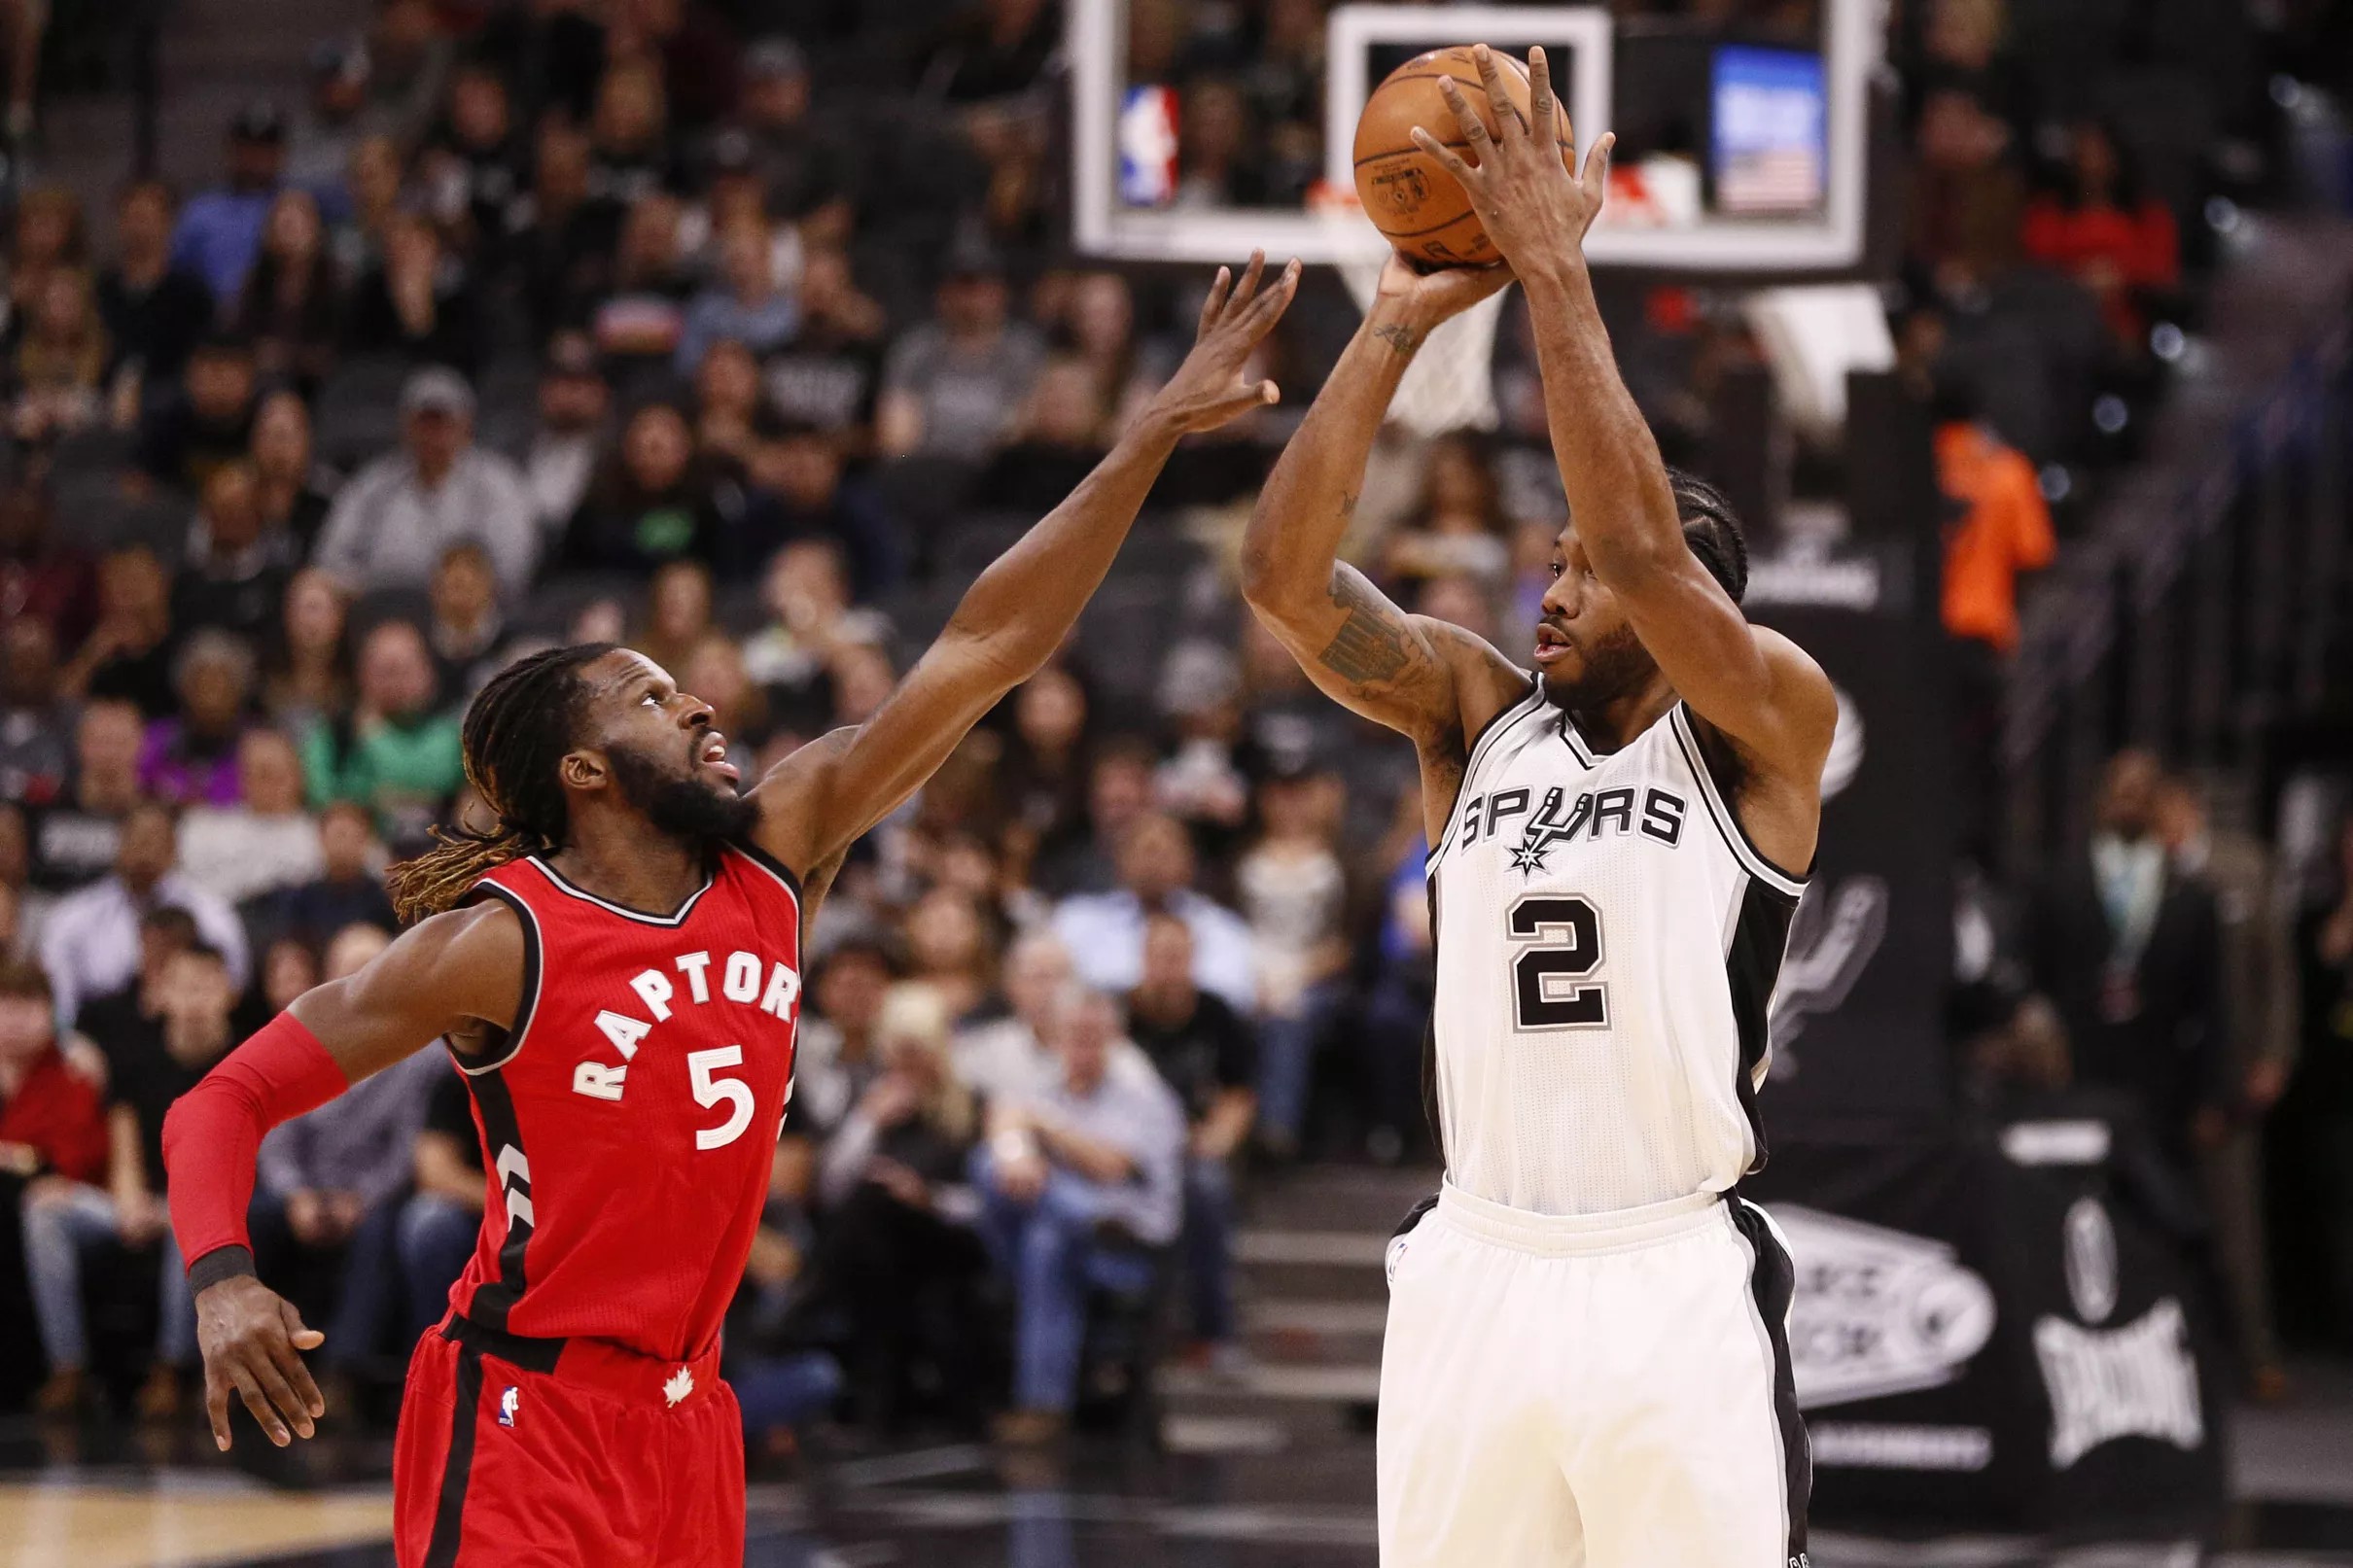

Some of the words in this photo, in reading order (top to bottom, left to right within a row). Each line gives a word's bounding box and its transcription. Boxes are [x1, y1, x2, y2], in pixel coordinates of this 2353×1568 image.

[1461, 784, 1688, 877] SPURS
[1505, 891, 1612, 1034] 2
[687, 1044, 755, 1151] 5
